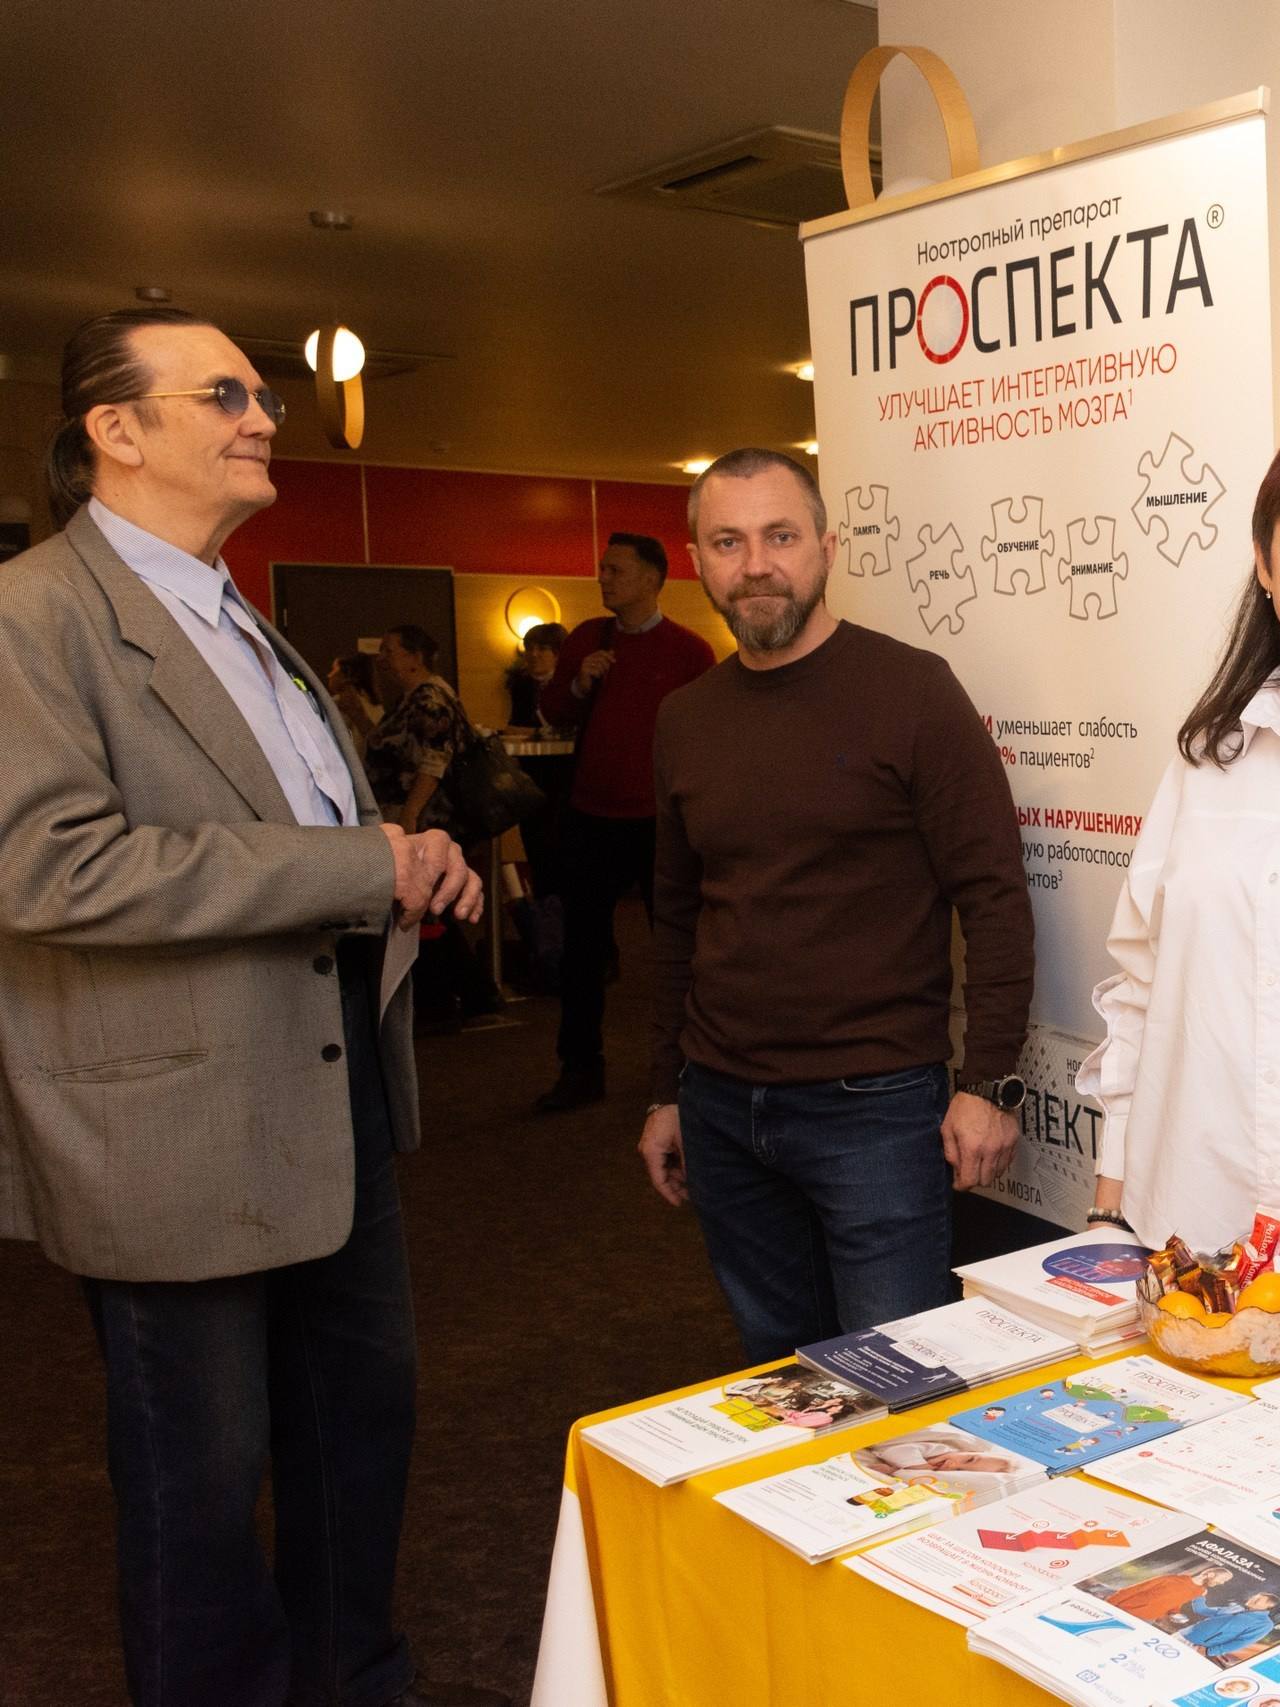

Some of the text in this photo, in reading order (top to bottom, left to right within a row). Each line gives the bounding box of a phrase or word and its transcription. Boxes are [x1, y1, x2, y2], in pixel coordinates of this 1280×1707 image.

[917, 197, 1122, 265] Ноотропный препарат
[877, 343, 1177, 421] УЛУЧШАЕТ ИНТЕГРАТИВНУЮ
[914, 405, 1053, 452] АКТИВНОСТЬ
[1146, 491, 1208, 508] МЫШЛЕНИЕ
[853, 524, 881, 536] ПАМЯТЬ
[997, 540, 1039, 553] ОБУЧЕНИЕ
[929, 569, 950, 581] РЕЧЬ
[1071, 562, 1113, 576] ВНИМАНИЕ
[996, 720, 1072, 740] уменьшает
[1078, 716, 1138, 738] слабость
[1015, 807, 1143, 836] ЫХ НАРУШЕНИЯХ
[1048, 840, 1133, 868] работоспосо
[1007, 1180, 1042, 1206] МОЗГА
[976, 1310, 1043, 1343] ПРОСПЕКТА
[1133, 1371, 1201, 1400] ПРОСПЕКТА
[928, 1532, 945, 1543] ШАГ
